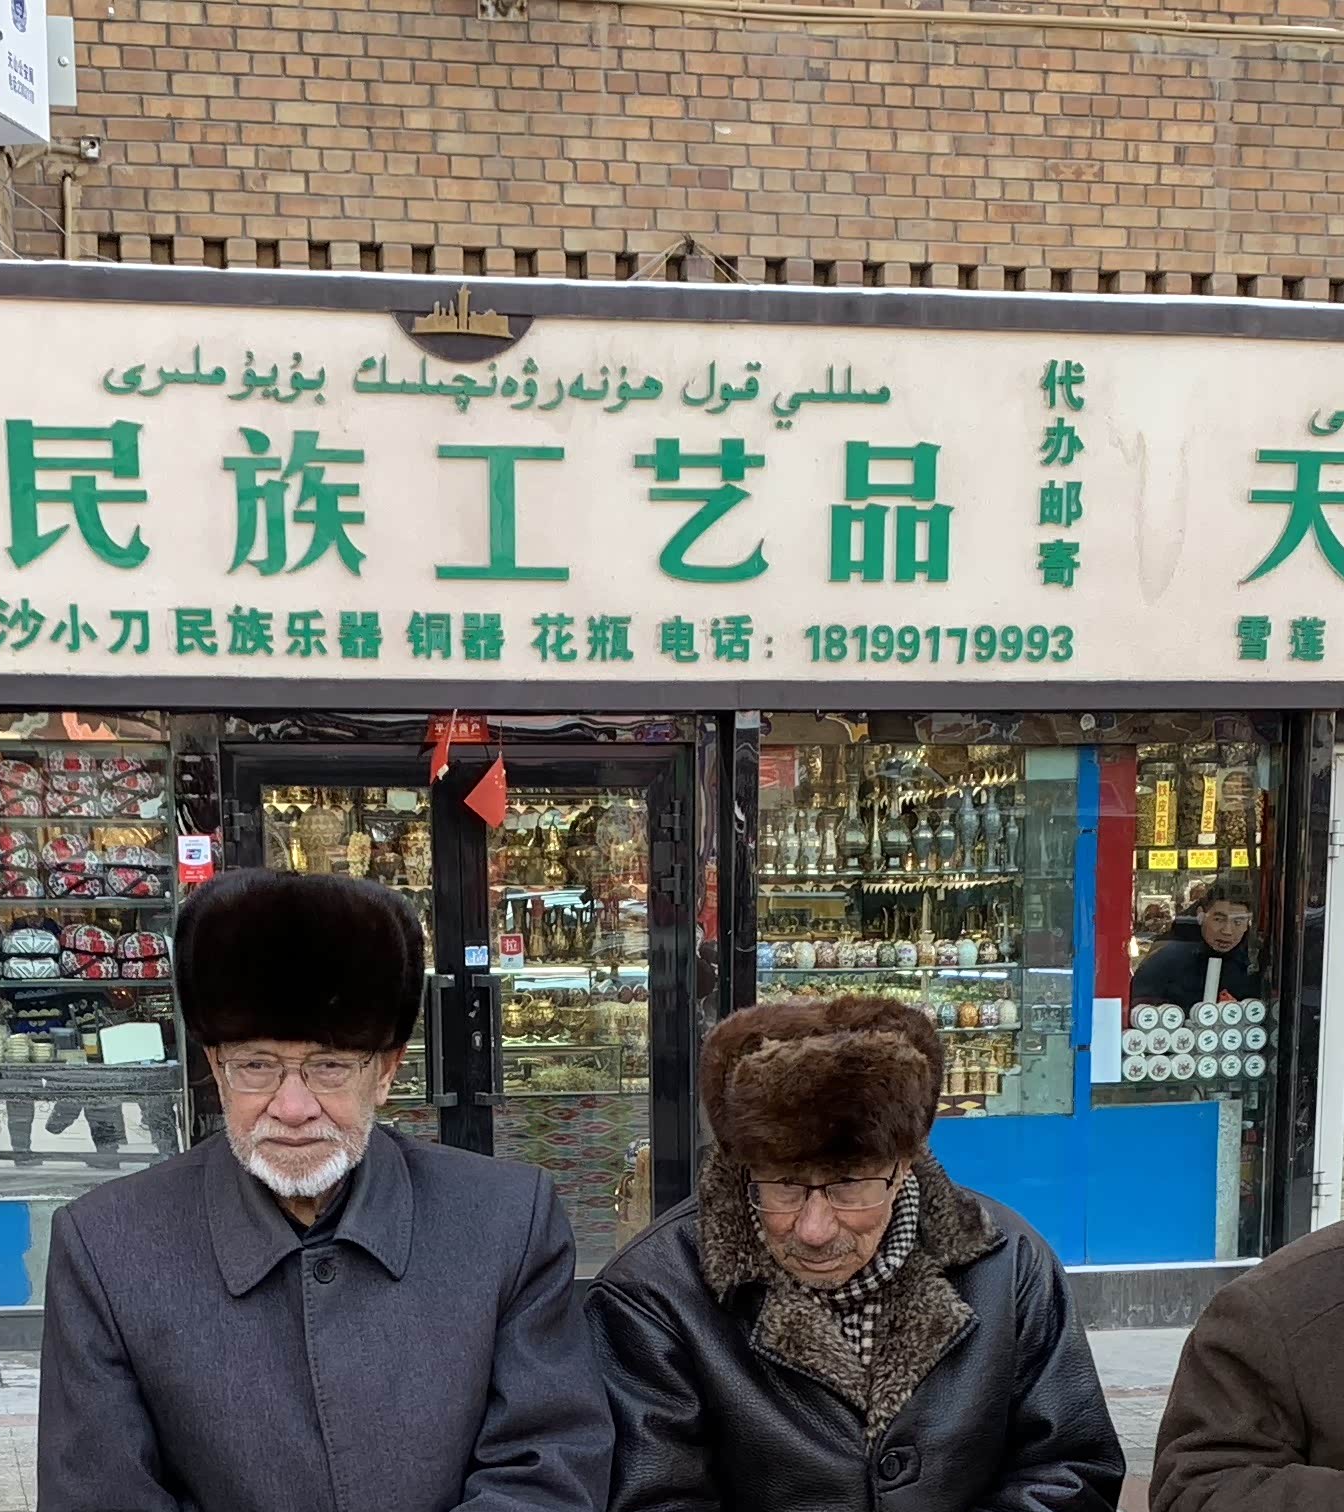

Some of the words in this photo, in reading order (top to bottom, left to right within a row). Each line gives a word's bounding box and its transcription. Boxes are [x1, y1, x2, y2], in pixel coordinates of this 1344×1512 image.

[683, 361, 763, 415] قول
[4, 418, 956, 585] 民族工艺品
[1039, 359, 1087, 589] 代办邮寄
[175, 606, 384, 660] 民族乐器
[407, 612, 506, 662] 铜器
[531, 613, 636, 664] 花瓶
[805, 624, 1076, 665] 18199179993
[1236, 614, 1327, 663] 雪莲
